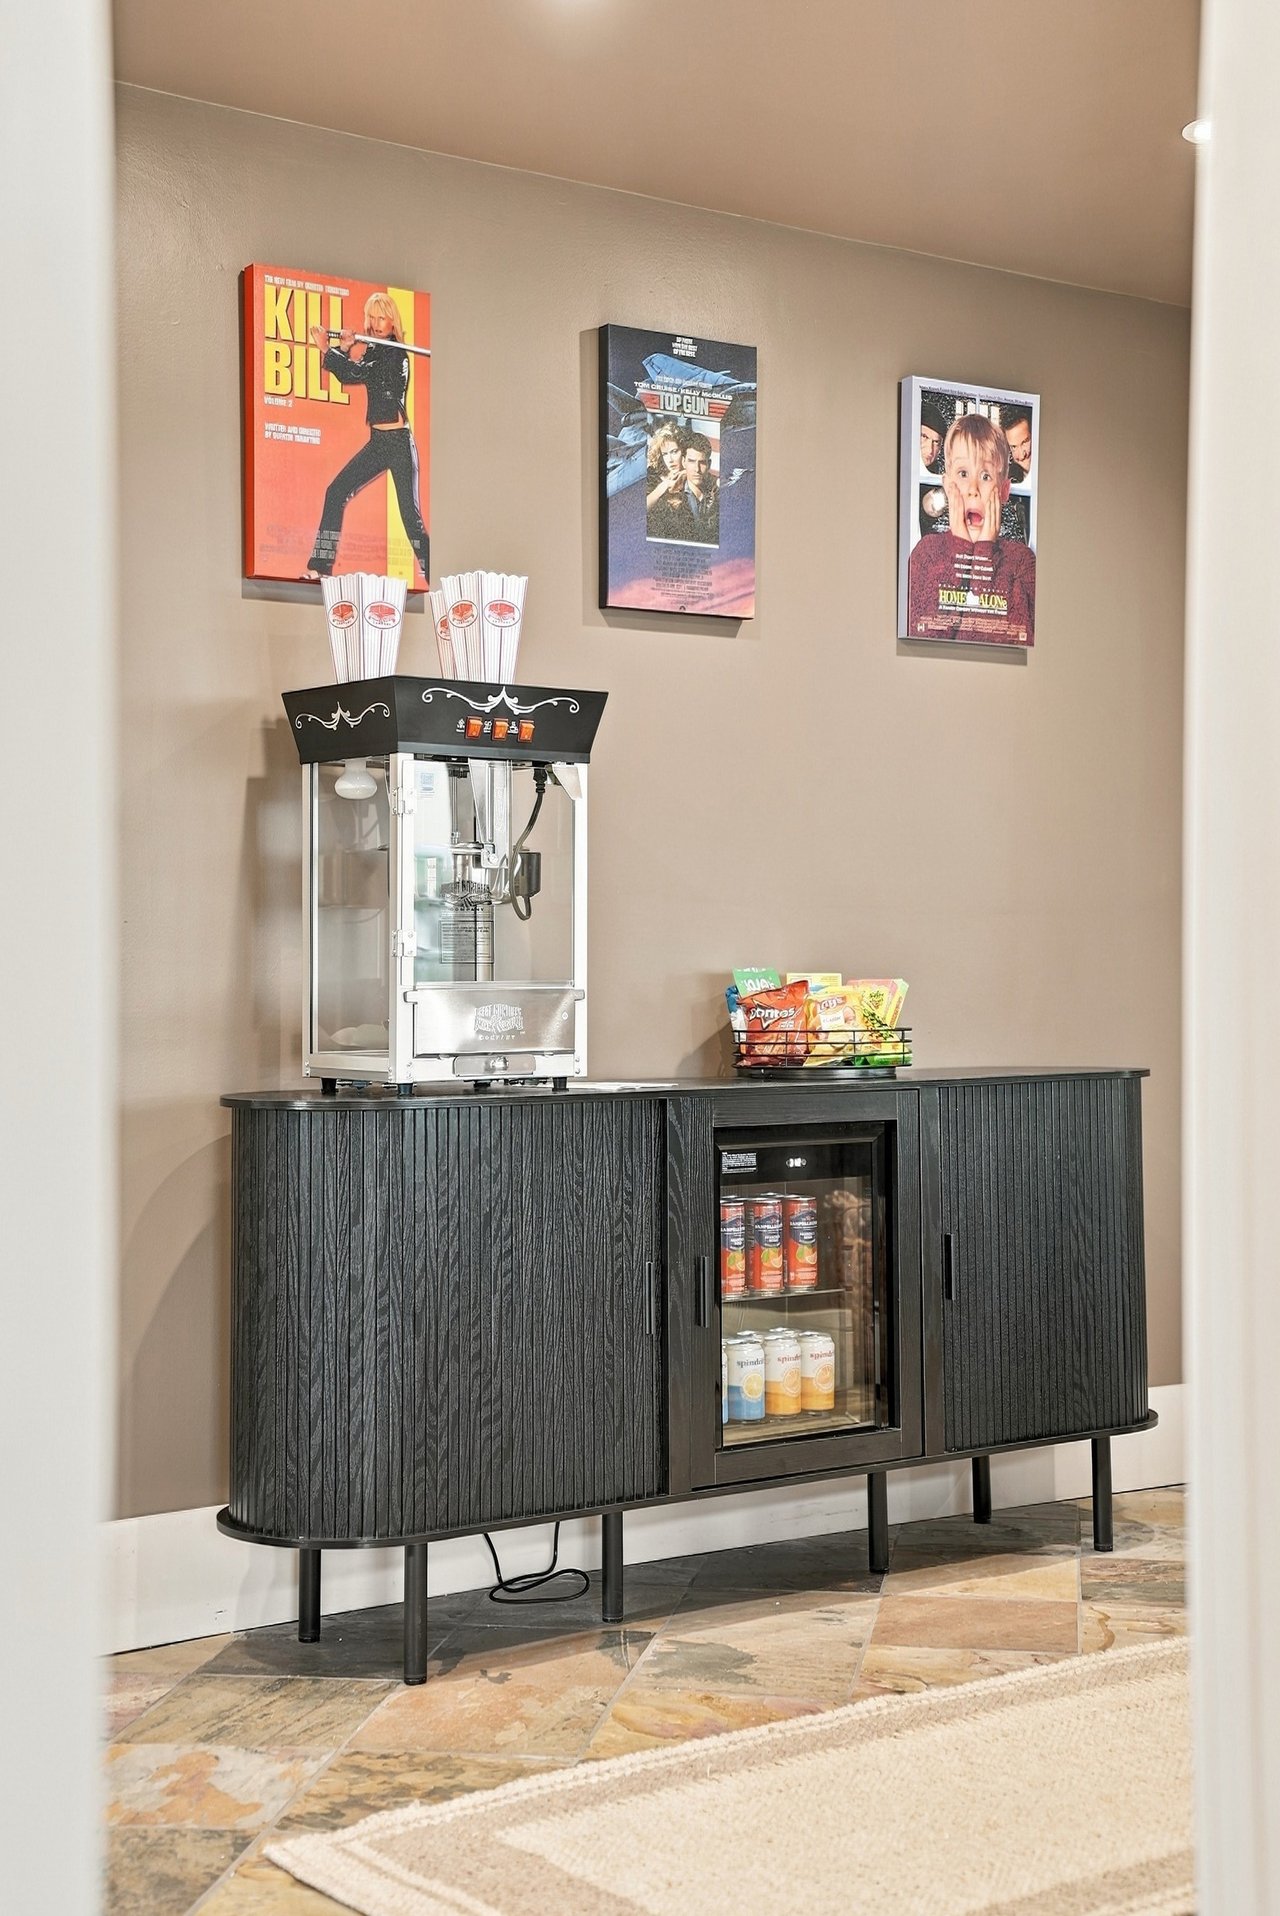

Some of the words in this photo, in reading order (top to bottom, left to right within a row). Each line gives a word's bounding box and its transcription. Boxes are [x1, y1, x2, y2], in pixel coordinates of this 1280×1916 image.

[264, 283, 344, 349] KILL
[264, 341, 350, 405] BILL
[634, 381, 650, 389] TOM
[659, 391, 681, 411] TOP
[682, 395, 709, 416] GUN
[939, 589, 967, 605] HOME
